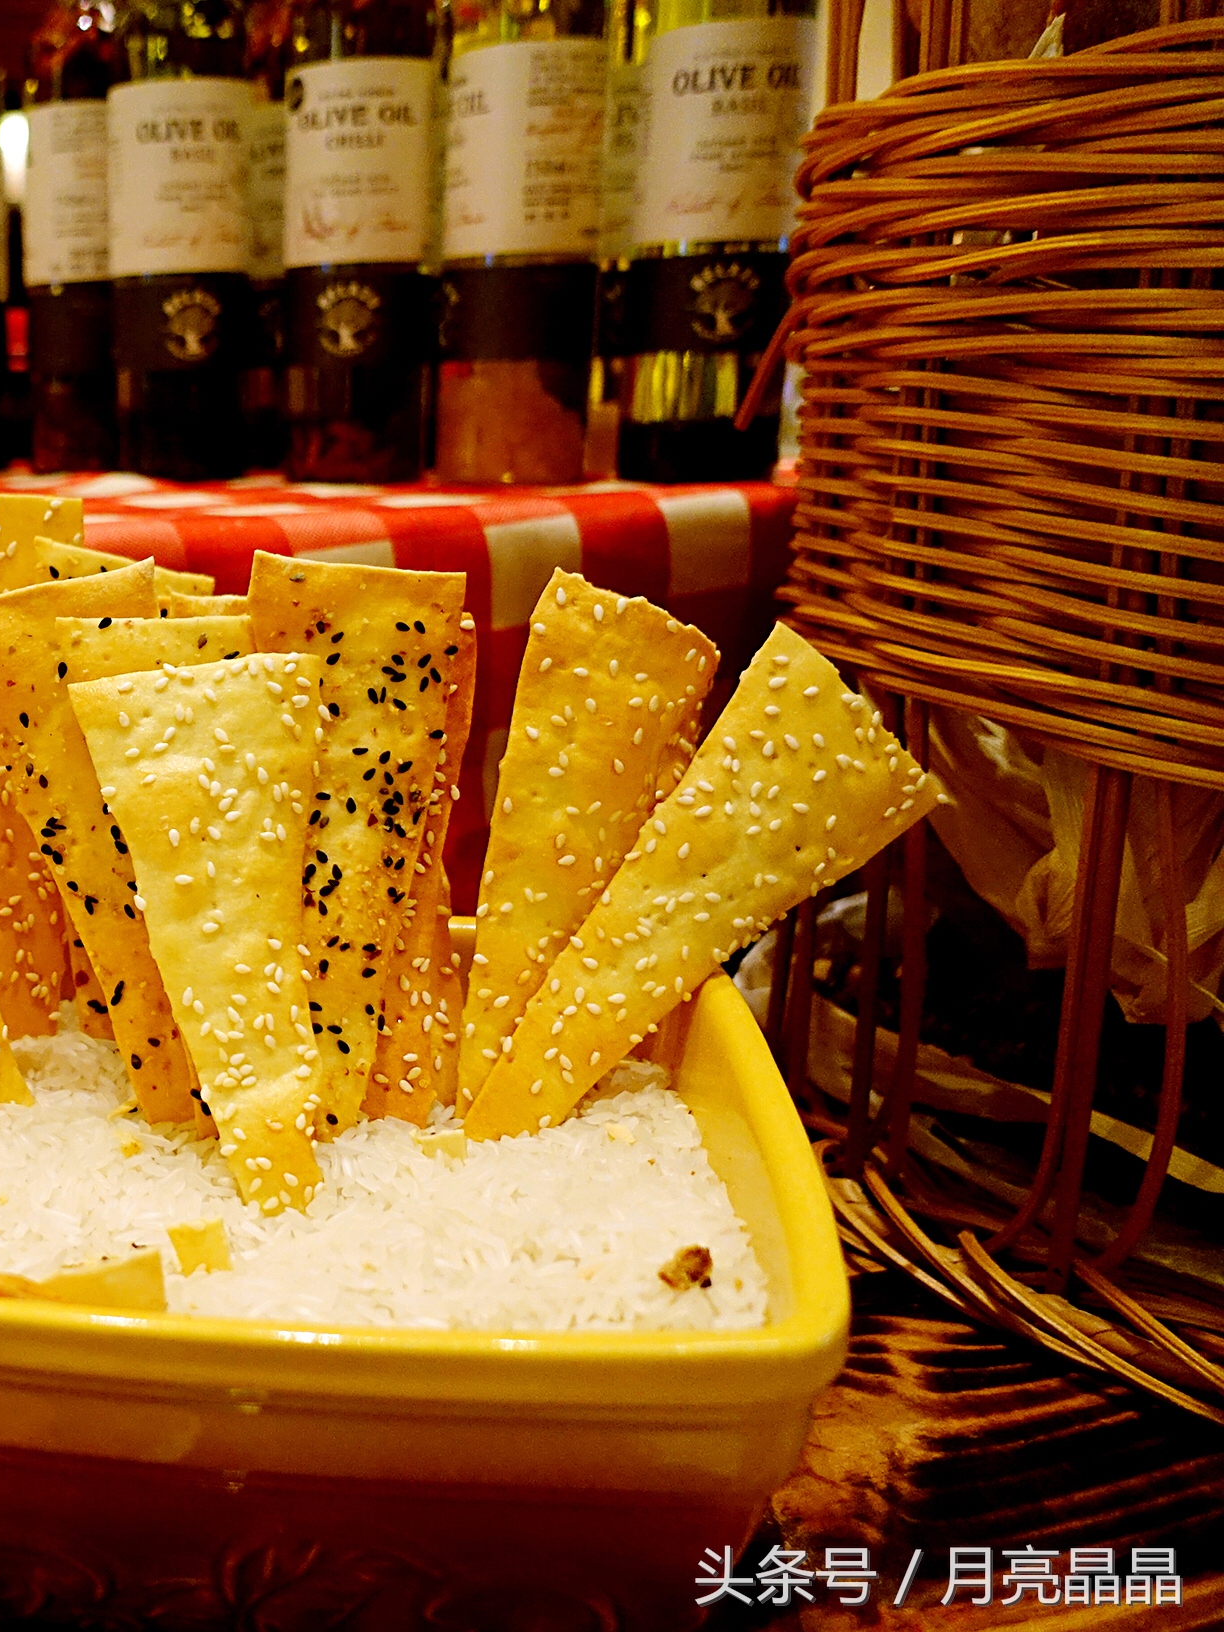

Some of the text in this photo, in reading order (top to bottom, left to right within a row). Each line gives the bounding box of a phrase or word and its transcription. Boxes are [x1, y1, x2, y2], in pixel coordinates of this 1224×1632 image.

[672, 64, 756, 97] OLIVE
[135, 119, 206, 144] OLIVE
[298, 101, 419, 132] OLIVE OIL
